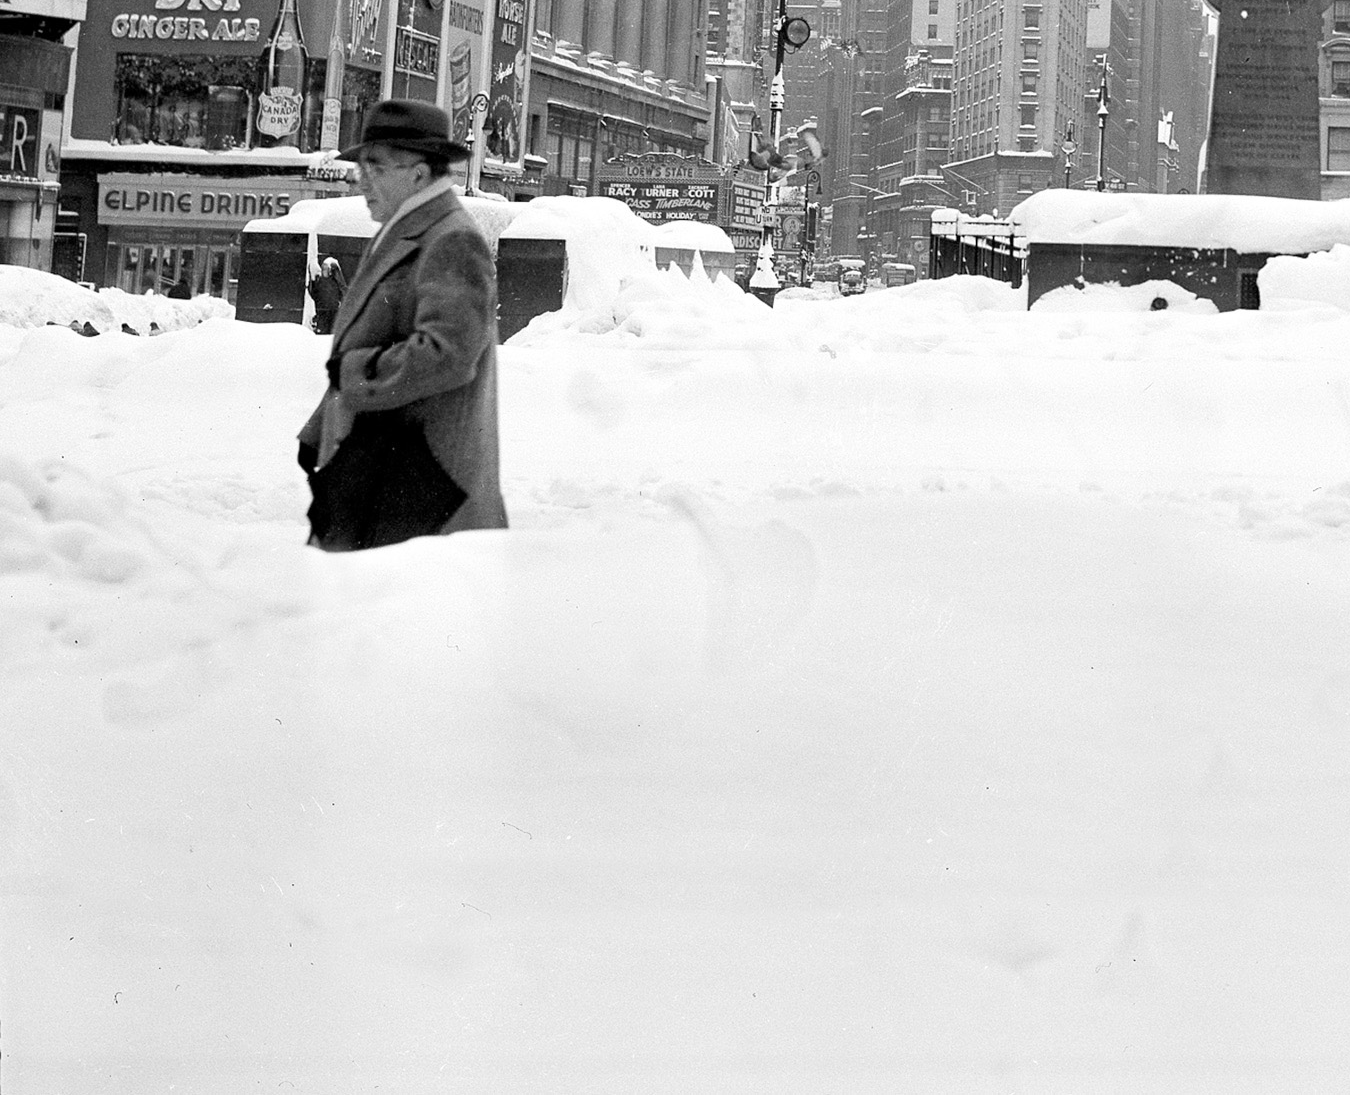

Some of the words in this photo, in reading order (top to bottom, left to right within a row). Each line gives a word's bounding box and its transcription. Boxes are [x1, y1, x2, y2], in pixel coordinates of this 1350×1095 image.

[111, 13, 210, 41] GINGER
[211, 17, 261, 42] ALE
[501, 22, 518, 46] ALE
[262, 106, 298, 115] CANADA
[627, 166, 662, 178] LOEW'S
[665, 167, 695, 178] STATE
[603, 186, 637, 197] TRACY
[640, 187, 680, 198] TURNER
[682, 188, 716, 199] SCOTT
[104, 189, 192, 212] ELPINE
[200, 192, 290, 217] DRINKS
[632, 211, 663, 220] LONDIE'S
